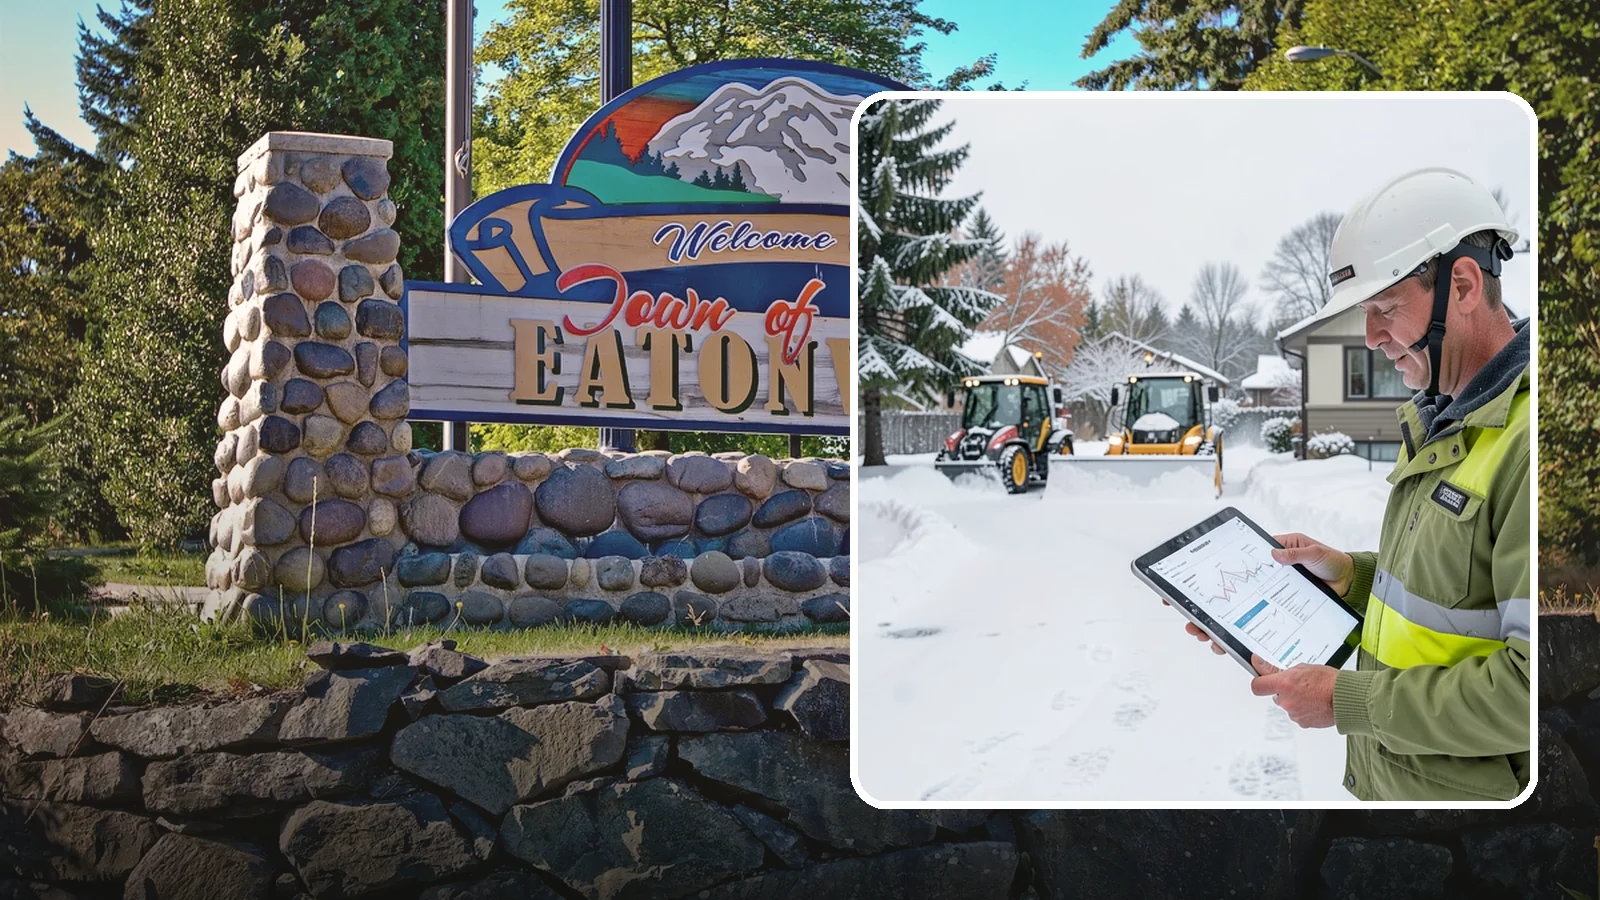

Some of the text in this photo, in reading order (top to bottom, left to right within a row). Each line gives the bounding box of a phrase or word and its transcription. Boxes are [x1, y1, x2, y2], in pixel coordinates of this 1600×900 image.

[654, 221, 837, 263] Welcome
[557, 264, 825, 365] Town of
